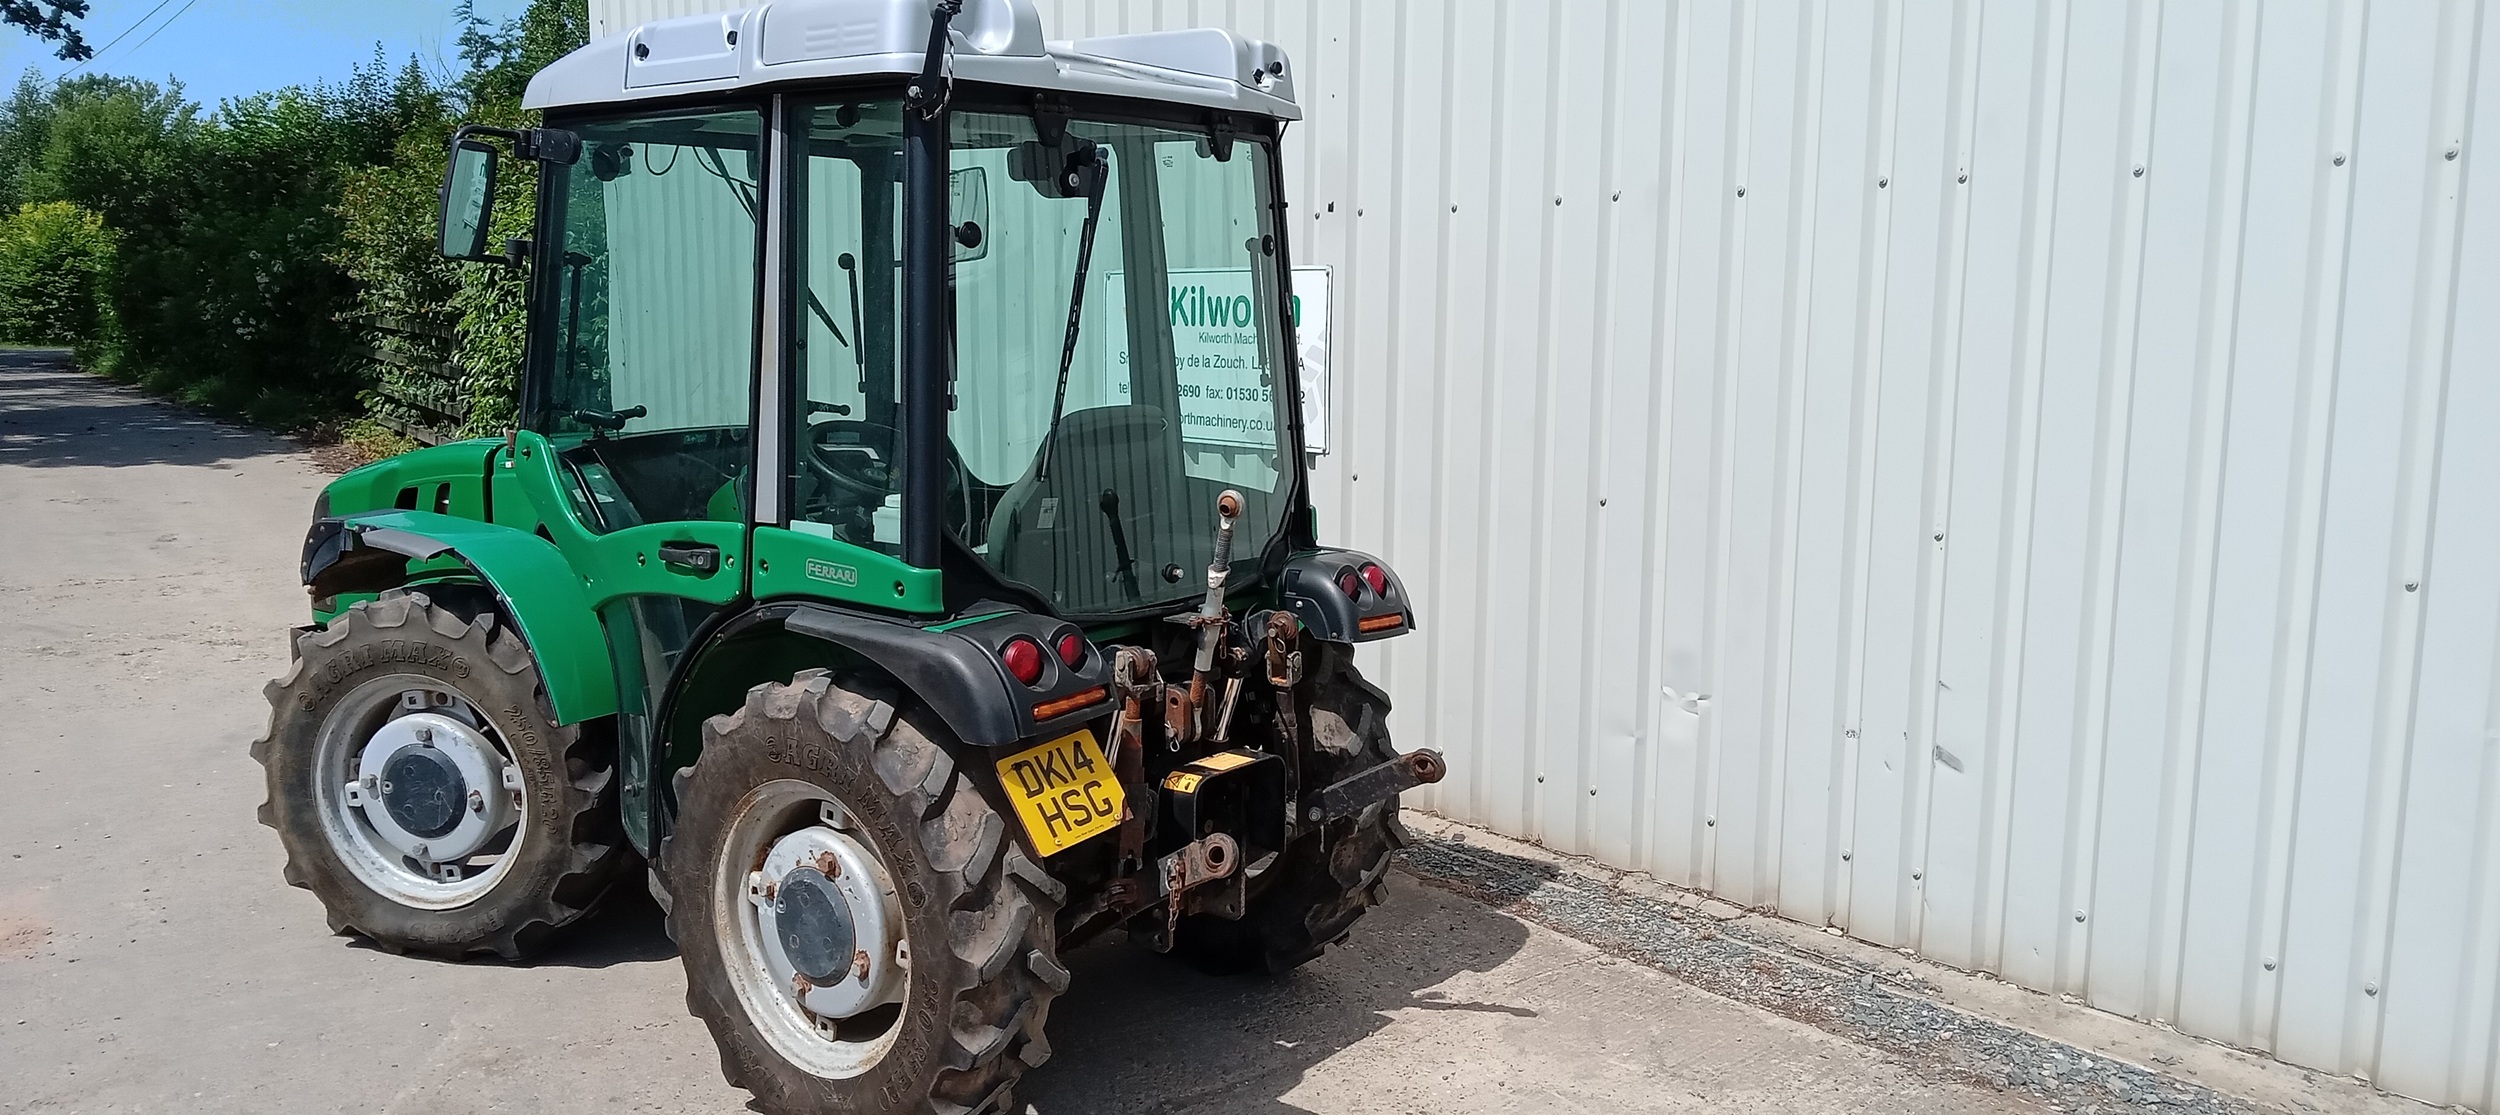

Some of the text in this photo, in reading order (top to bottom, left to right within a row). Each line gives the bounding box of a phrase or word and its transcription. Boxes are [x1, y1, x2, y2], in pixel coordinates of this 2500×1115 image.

[1171, 285, 1301, 328] Kilwo
[1198, 331, 1233, 344] Kilworth
[1187, 354, 1200, 368] de
[1202, 354, 1211, 369] la
[1206, 385, 1223, 400] fax:
[1226, 386, 1259, 402] 01530
[808, 562, 855, 583] FERRARI
[1013, 740, 1094, 799] DK14
[1037, 779, 1114, 838] HSG
